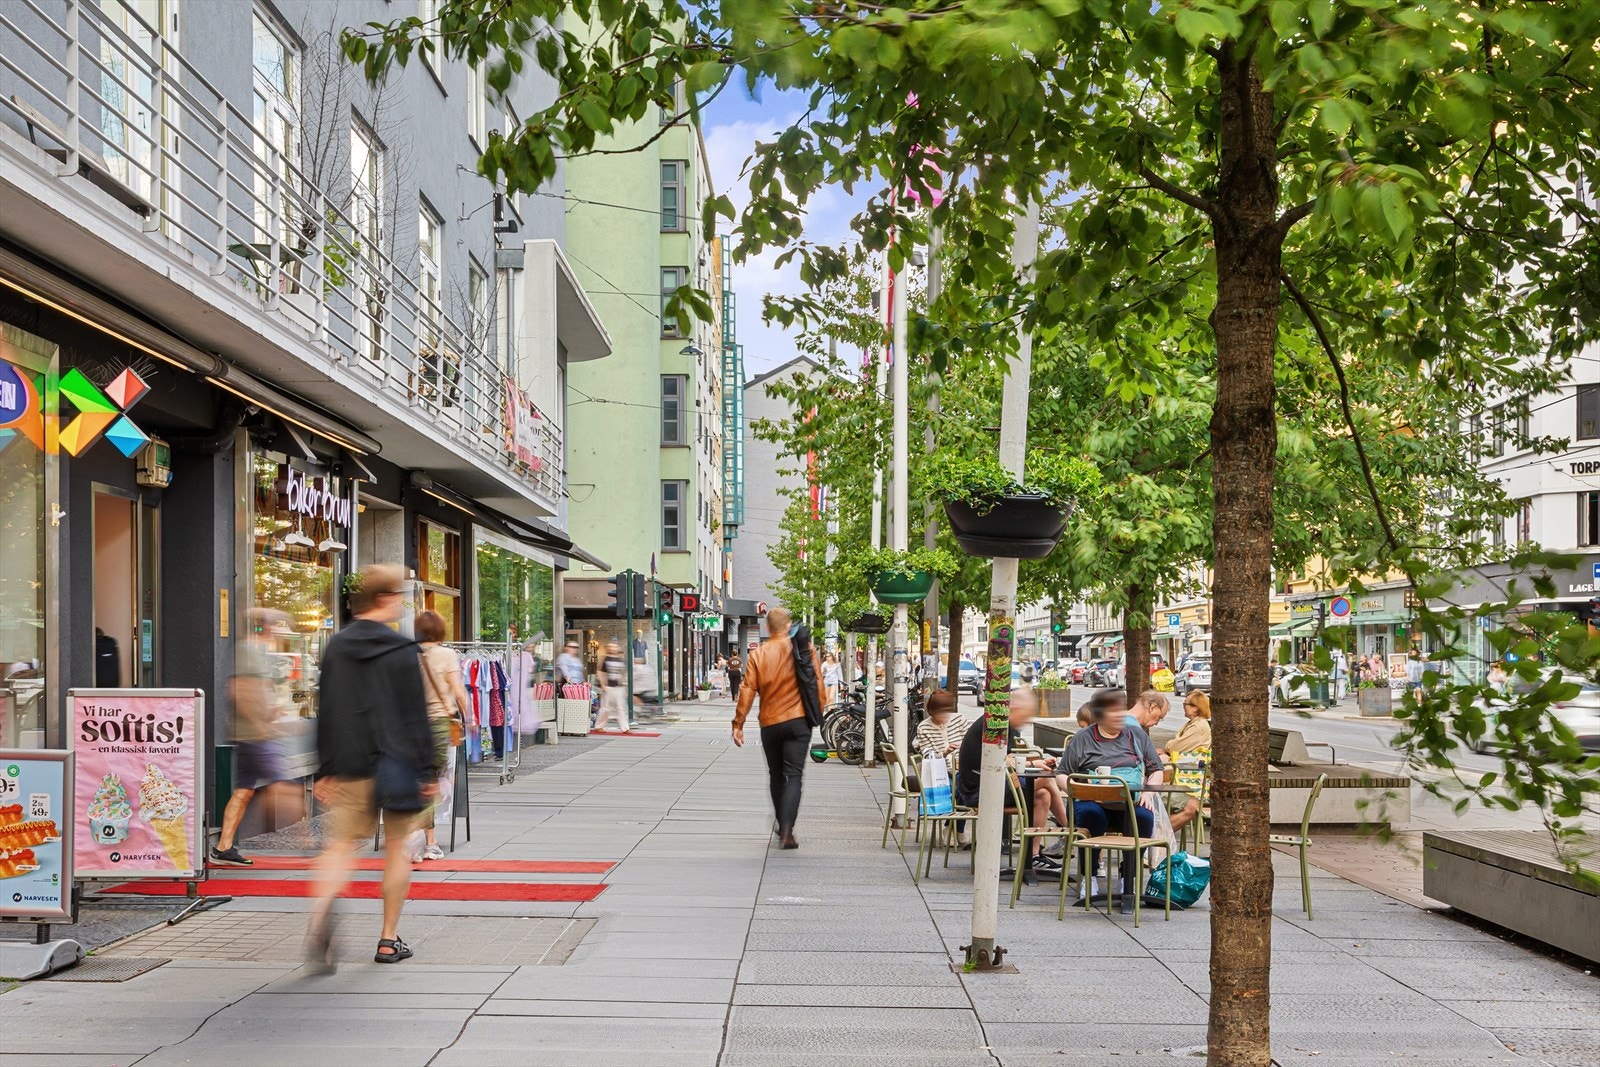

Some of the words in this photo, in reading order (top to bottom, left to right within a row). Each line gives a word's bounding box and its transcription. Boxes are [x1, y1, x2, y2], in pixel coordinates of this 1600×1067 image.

[683, 595, 697, 610] D
[1170, 616, 1178, 625] P
[83, 705, 95, 717] Vi
[98, 706, 122, 717] har
[80, 713, 184, 744] softis!
[98, 745, 109, 753] en
[111, 745, 147, 754] klassisk
[148, 745, 180, 754] favoritt
[32, 799, 38, 807] 2
